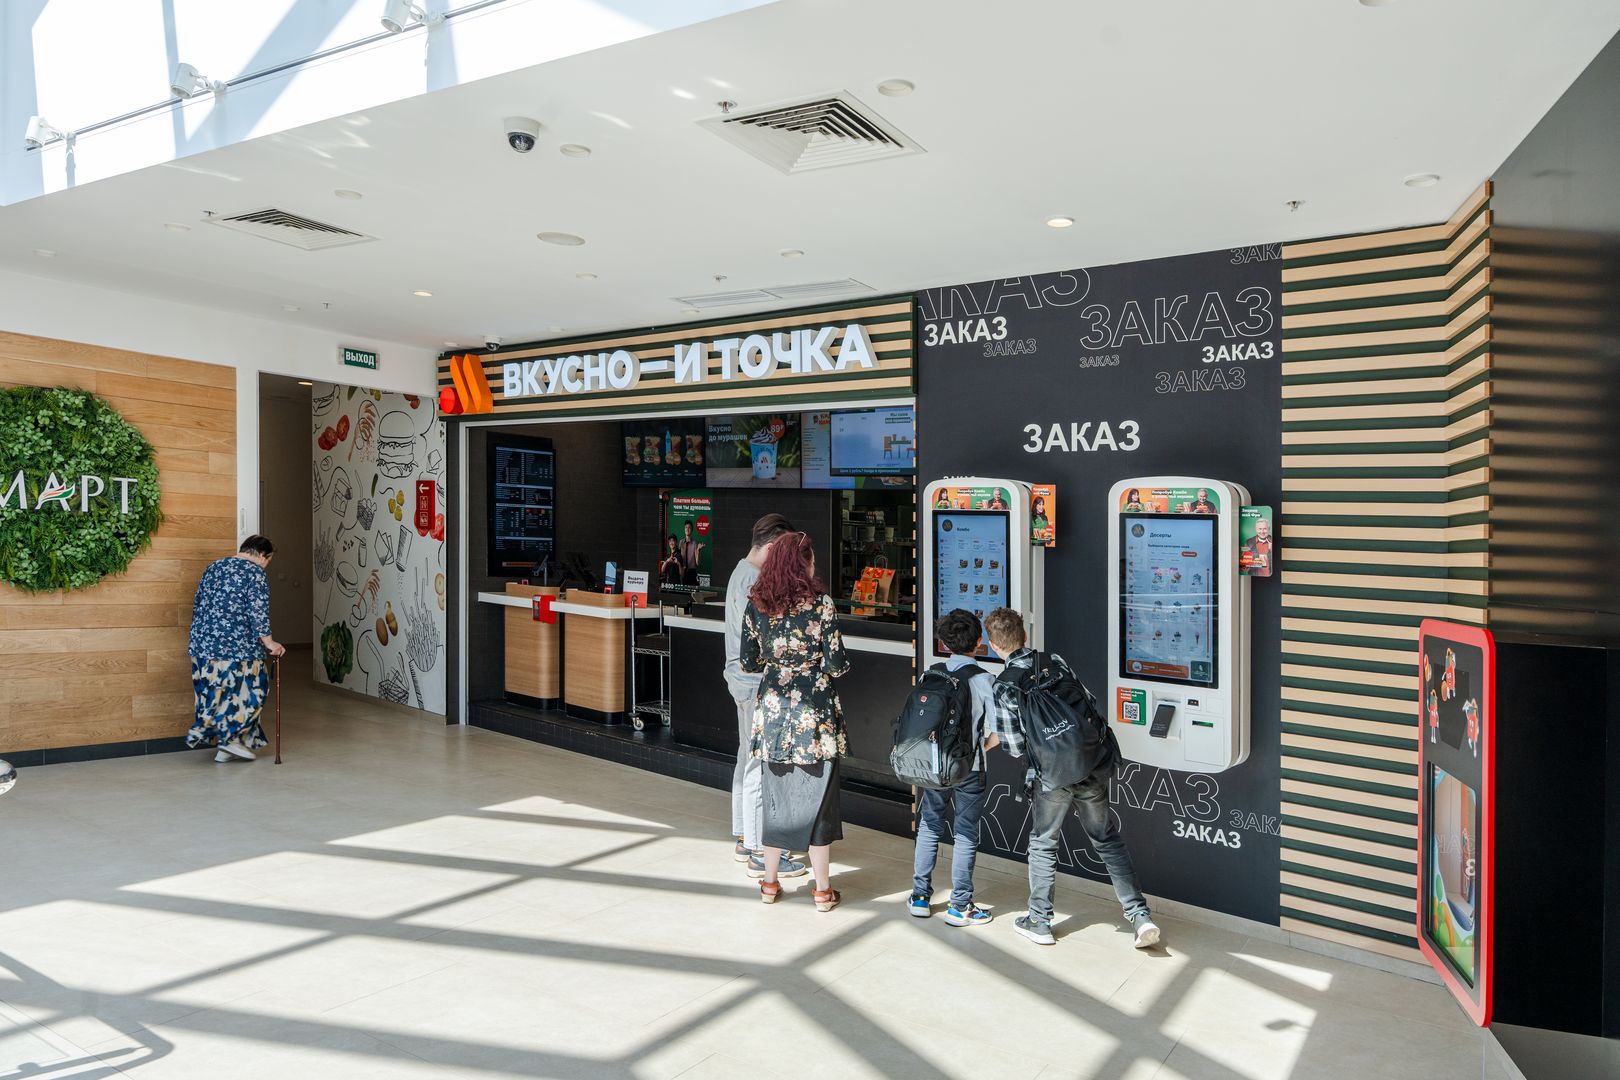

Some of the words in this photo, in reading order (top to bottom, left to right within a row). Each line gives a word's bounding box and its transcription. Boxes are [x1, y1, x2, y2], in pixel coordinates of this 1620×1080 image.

[1230, 243, 1282, 265] ЗАК
[1080, 286, 1274, 350] ЗАКАЗ
[924, 316, 1008, 347] ЗАКАЗ
[345, 351, 375, 366] ВЫХОД
[983, 338, 1037, 358] ЗАКАЗ
[1202, 341, 1274, 363] ЗАКАЗ
[503, 350, 641, 398] ВКУСНО
[674, 343, 709, 384] И
[713, 323, 879, 379] ТОЧКА
[1079, 354, 1120, 368] ЗАКАЗ
[1155, 367, 1246, 393] ЗАКАЗ
[709, 425, 732, 434] Вкусно
[718, 432, 748, 442] мурашек
[1022, 420, 1141, 453] ЗАКАЗ
[1172, 820, 1241, 849] ЗАКАЗ
[1229, 809, 1281, 836] ЗАК
